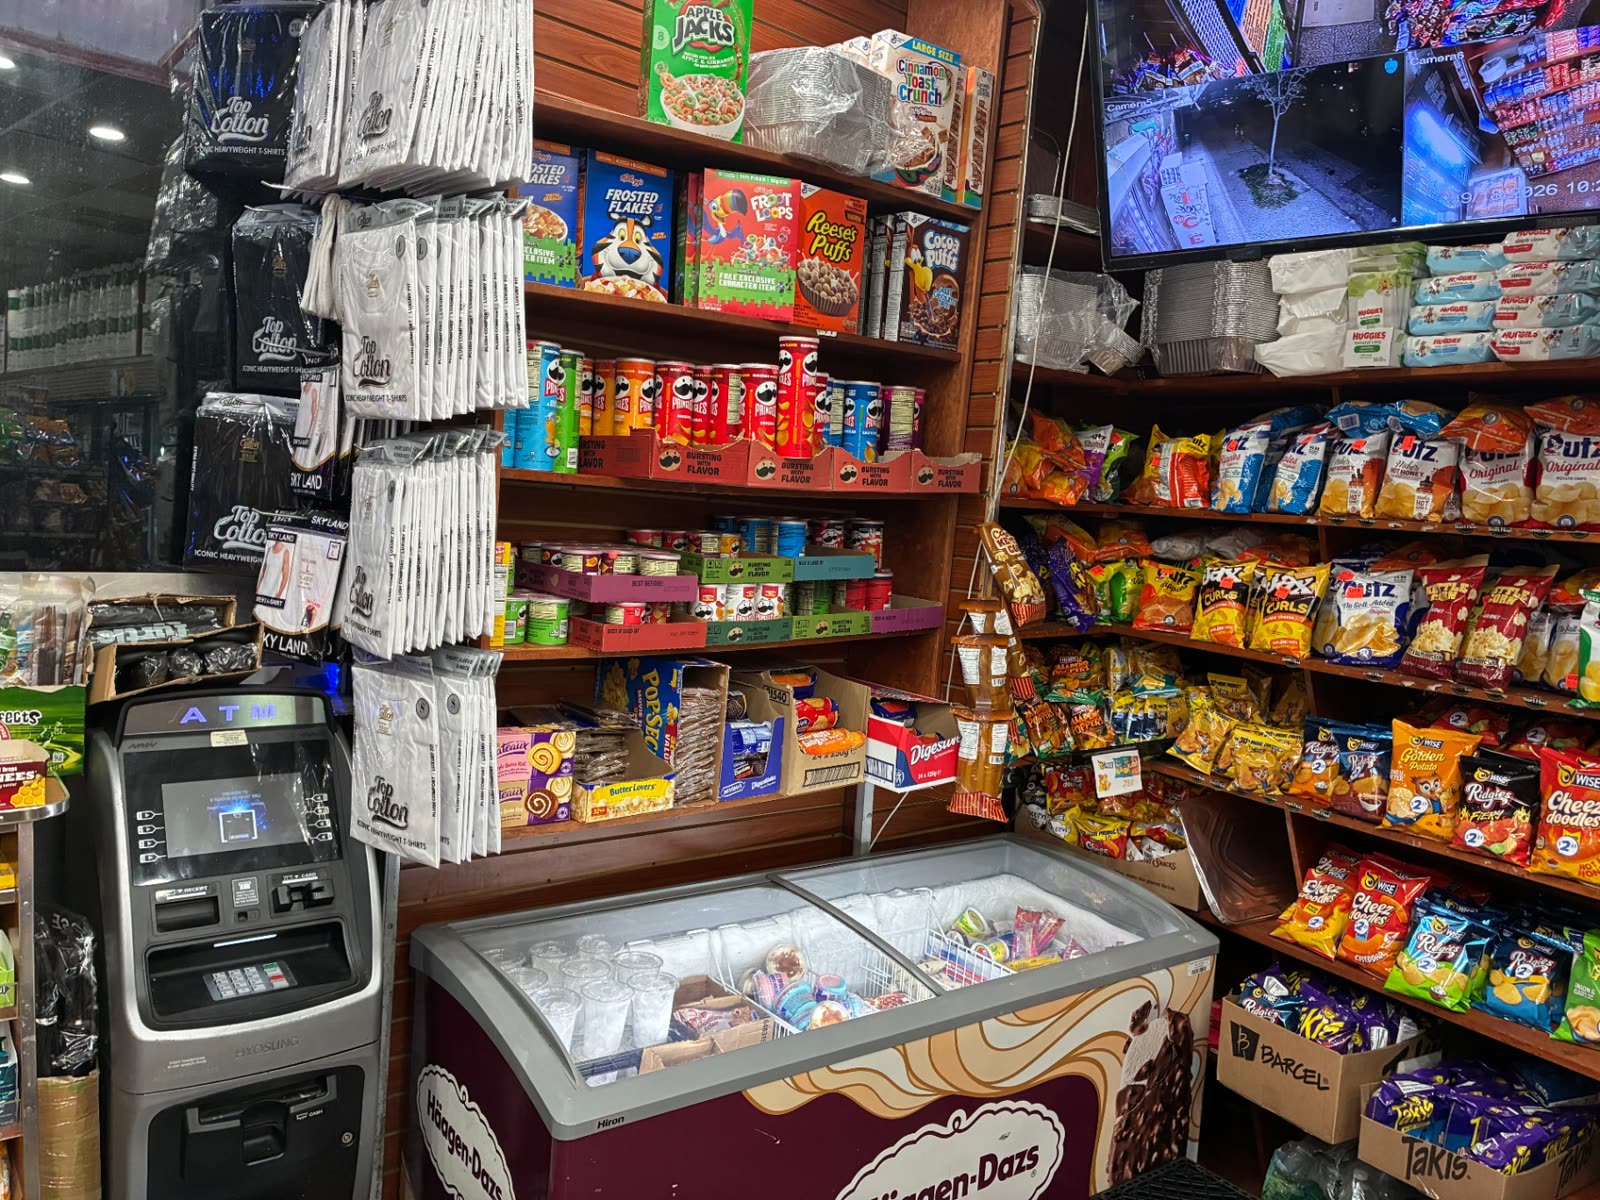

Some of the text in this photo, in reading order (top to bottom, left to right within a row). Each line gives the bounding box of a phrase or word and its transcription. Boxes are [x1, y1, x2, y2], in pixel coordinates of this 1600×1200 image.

[686, 6, 723, 21] APPLE
[673, 17, 734, 53] JACKS
[912, 40, 954, 62] LARGE SIZE
[1409, 49, 1465, 67] Camera6
[898, 59, 946, 79] Cinnamon
[907, 73, 937, 91] Toast
[899, 84, 943, 107] Crunch
[226, 96, 252, 114] Top
[211, 107, 269, 134] Cotton
[214, 146, 285, 156] HEAVYWEIGHT T-SHIRTS
[605, 189, 659, 203] FROSTED
[750, 192, 792, 210] FROOT
[608, 201, 654, 214] FLAKES
[755, 206, 793, 222] LOOPS
[807, 212, 857, 242] Reese's
[811, 234, 852, 262] Puffs
[924, 230, 960, 254] Cocoa
[537, 256, 555, 264] ITEM
[719, 272, 776, 285] FREE EXCLUSIVE
[719, 279, 776, 291] CHARACTER ITEM
[1358, 308, 1383, 316] HUGGIES
[263, 316, 283, 334] Top
[252, 325, 297, 354] Cotton
[1353, 332, 1386, 340] HUGGIES
[359, 336, 376, 356] Top
[257, 365, 290, 374] HEAVYWEIGHT
[352, 351, 391, 378] Cotton
[686, 451, 722, 462] BURSTING
[687, 465, 720, 476] FLAVOR
[782, 462, 814, 471] BURSTING
[862, 466, 890, 475] BURSTING
[938, 468, 964, 477] BURSTING
[1469, 463, 1519, 481] Original
[1546, 461, 1600, 476] Original
[782, 474, 811, 484] FLAVOR
[862, 477, 888, 487] FLAVOR
[938, 479, 962, 488] FLAVOR
[231, 505, 260, 524] Top
[214, 515, 266, 541] Cotto
[268, 532, 295, 542] SKY LAND
[195, 549, 263, 564] ICONIC HEAVYWEIGH
[1426, 583, 1469, 595] KETTLE
[1204, 591, 1239, 606] CURLS
[1266, 602, 1308, 615] CURLS
[279, 637, 308, 656] LAND
[180, 703, 276, 724] ATM
[1360, 741, 1379, 750] WISE
[1424, 739, 1441, 748] WISE
[1401, 749, 1445, 765] Golden
[1409, 762, 1438, 771] Potato
[374, 775, 393, 797] Top
[1490, 774, 1508, 784] WISE
[1576, 774, 1600, 789] WISE
[609, 785, 632, 796] Butter
[1465, 784, 1513, 810] Ridgies
[367, 787, 408, 824] Cotton
[1470, 810, 1504, 821] FIERY
[1546, 811, 1600, 828] doodles
[400, 836, 427, 850] T-SHIRTS
[1579, 862, 1595, 871] HOT
[184, 885, 208, 893] RECEIPT
[1303, 880, 1343, 893] Cheez
[1377, 882, 1396, 894] WISE
[1352, 892, 1395, 915] Cheez
[1446, 929, 1464, 941] WISE
[1417, 933, 1461, 960] Ridgies
[1355, 952, 1387, 963] CHEDDAR
[1510, 951, 1556, 972] Ridgies
[235, 1036, 299, 1058] HYOSUNG
[1261, 1044, 1330, 1091] BARCEL
[309, 1109, 323, 1117] CASH
[1392, 1097, 1434, 1131] Takis
[597, 1115, 625, 1130] Hiron
[427, 1089, 503, 1200] Häagen-Dazs
